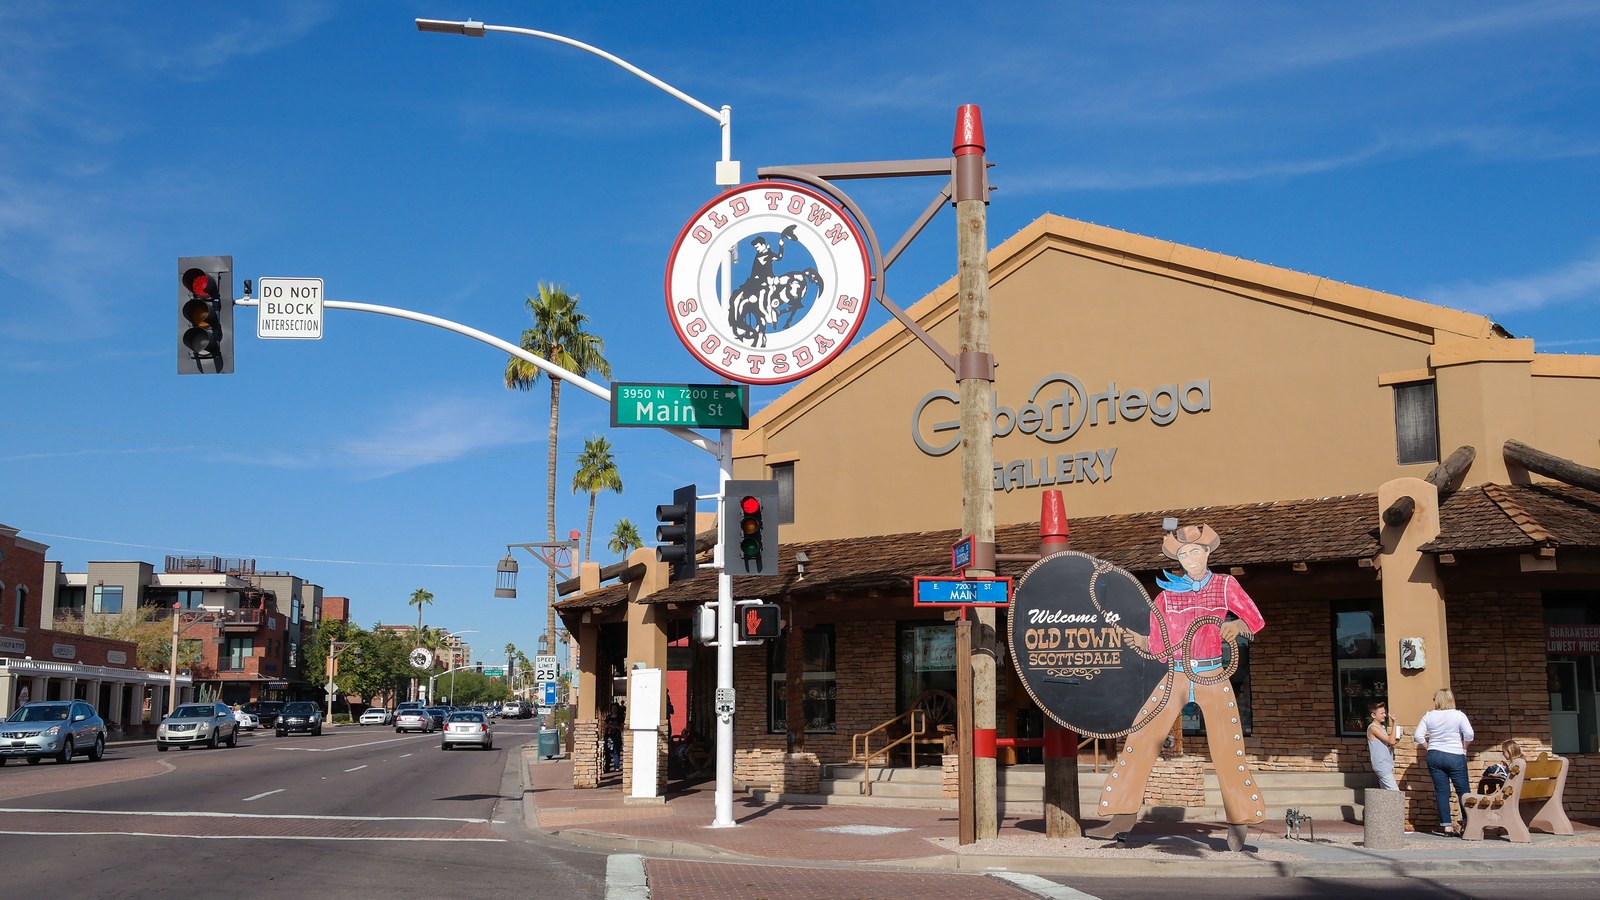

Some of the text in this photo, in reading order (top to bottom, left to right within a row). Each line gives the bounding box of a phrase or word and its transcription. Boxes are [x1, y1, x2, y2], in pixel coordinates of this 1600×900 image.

[692, 191, 849, 245] OLD TOWN
[263, 286, 318, 299] DO NOT
[267, 302, 314, 315] BLOCK
[261, 319, 319, 331] INTERSECTION
[677, 294, 859, 375] SCOTTSDALE
[623, 388, 719, 400] 3950 N 7200 E
[636, 399, 723, 422] Main St
[1028, 372, 1212, 444] Ortega
[949, 590, 977, 600] MAIN
[1027, 608, 1121, 624] Welcome to
[1025, 627, 1124, 650] OLD TOWN
[1547, 641, 1576, 652] LOWEST
[1028, 652, 1121, 666] SCOTTSDALE
[537, 670, 555, 680] 25
